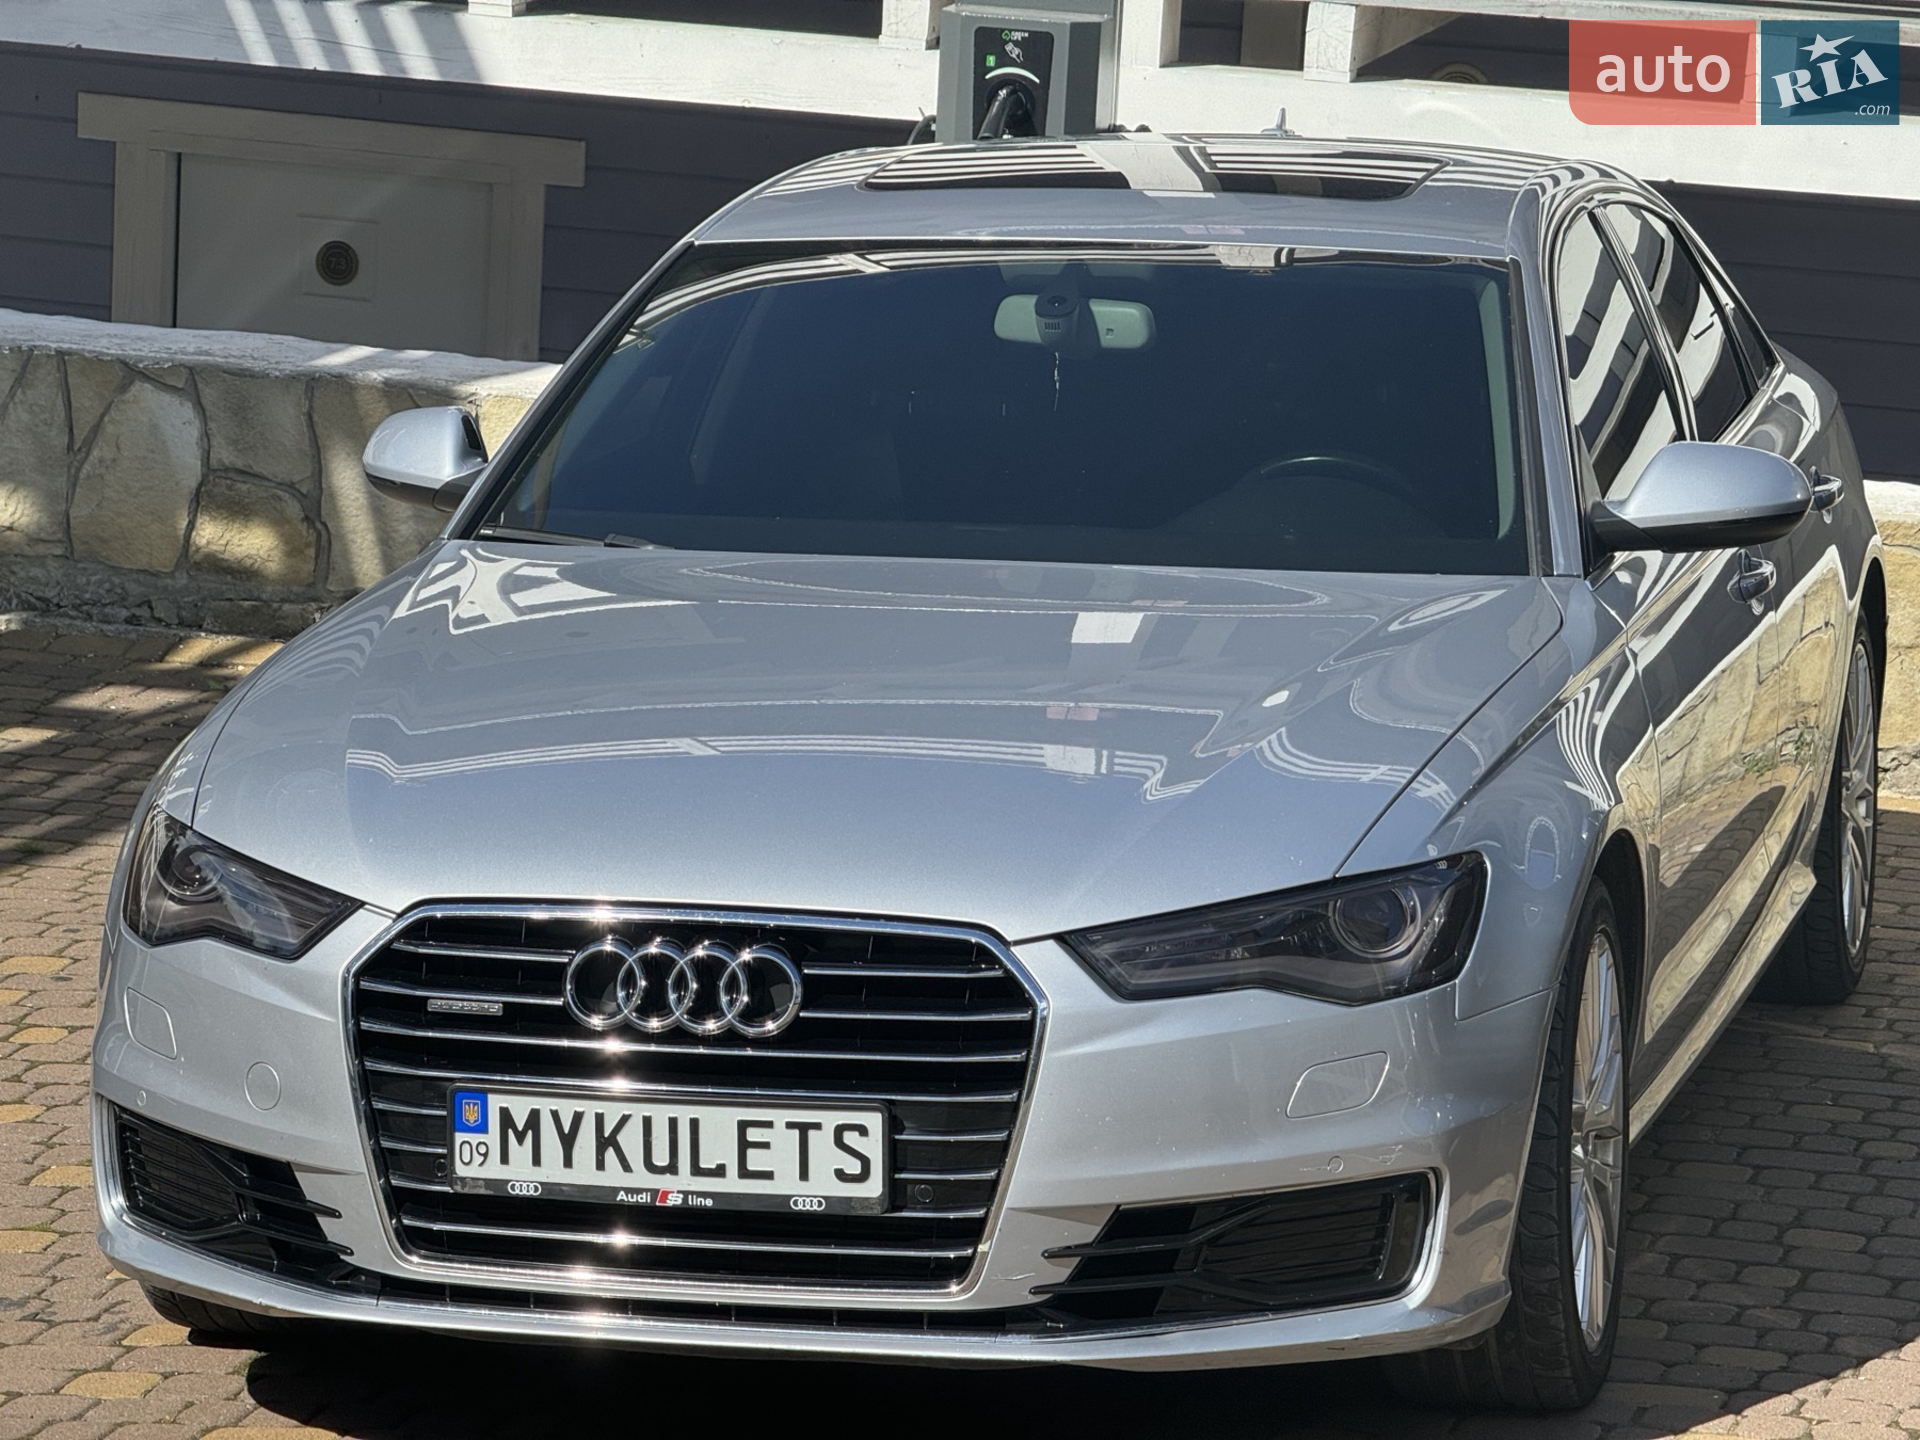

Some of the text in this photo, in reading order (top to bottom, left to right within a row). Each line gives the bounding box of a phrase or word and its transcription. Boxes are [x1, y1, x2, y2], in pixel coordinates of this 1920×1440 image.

[458, 1139, 490, 1168] 09
[498, 1104, 871, 1184] MYKULETS
[616, 1190, 651, 1203] Audi
[688, 1194, 713, 1206] line
